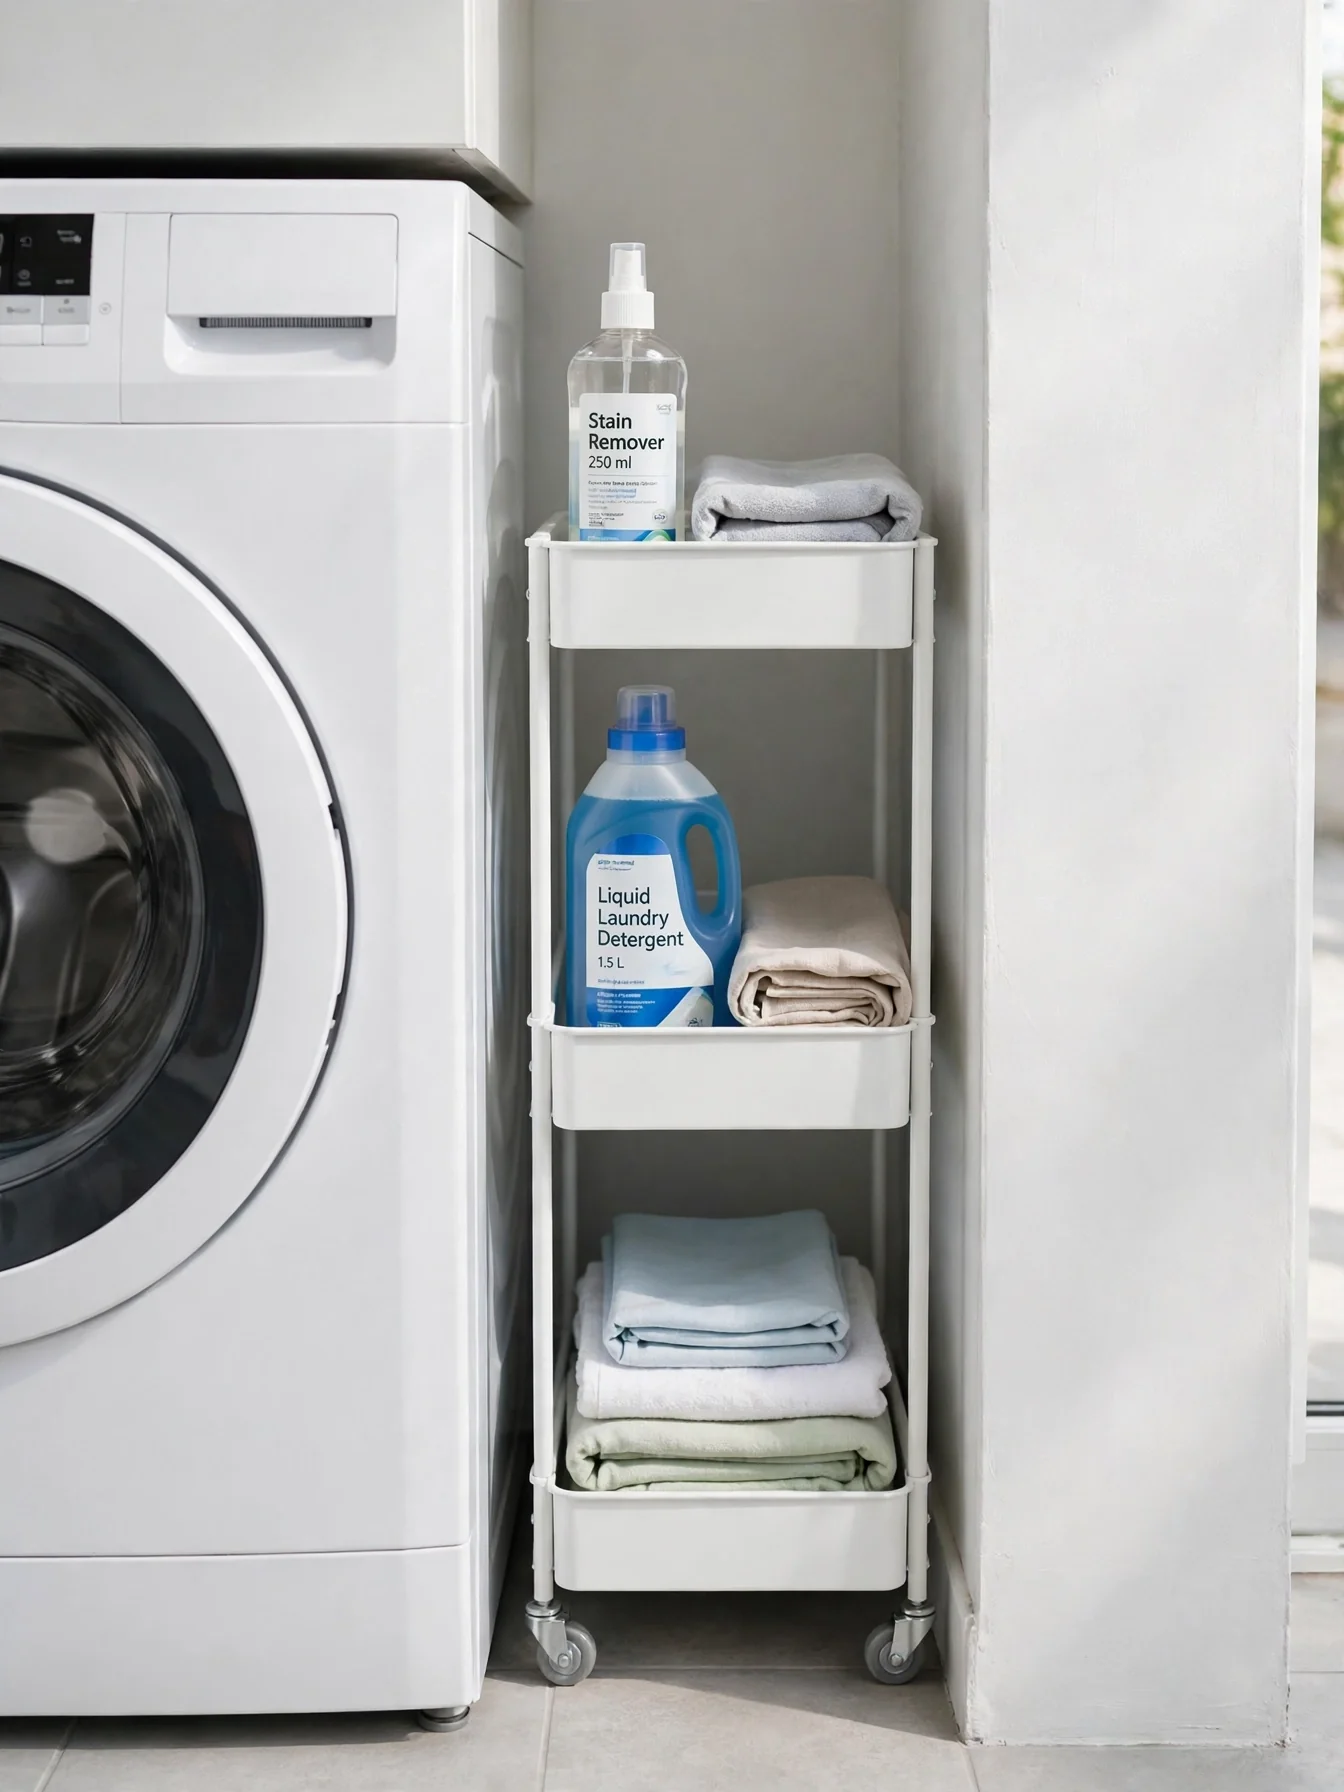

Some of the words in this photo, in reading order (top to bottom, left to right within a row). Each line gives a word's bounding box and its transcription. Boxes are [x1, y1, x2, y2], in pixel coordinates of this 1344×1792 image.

[588, 412, 632, 429] Stain
[589, 433, 665, 450] Remover
[588, 455, 612, 469] 250
[615, 455, 632, 469] ml
[598, 886, 650, 907] Liquid
[598, 908, 669, 930] Laundry
[598, 930, 684, 951] Detergent
[598, 956, 614, 968] 1.5
[617, 957, 624, 968] L
